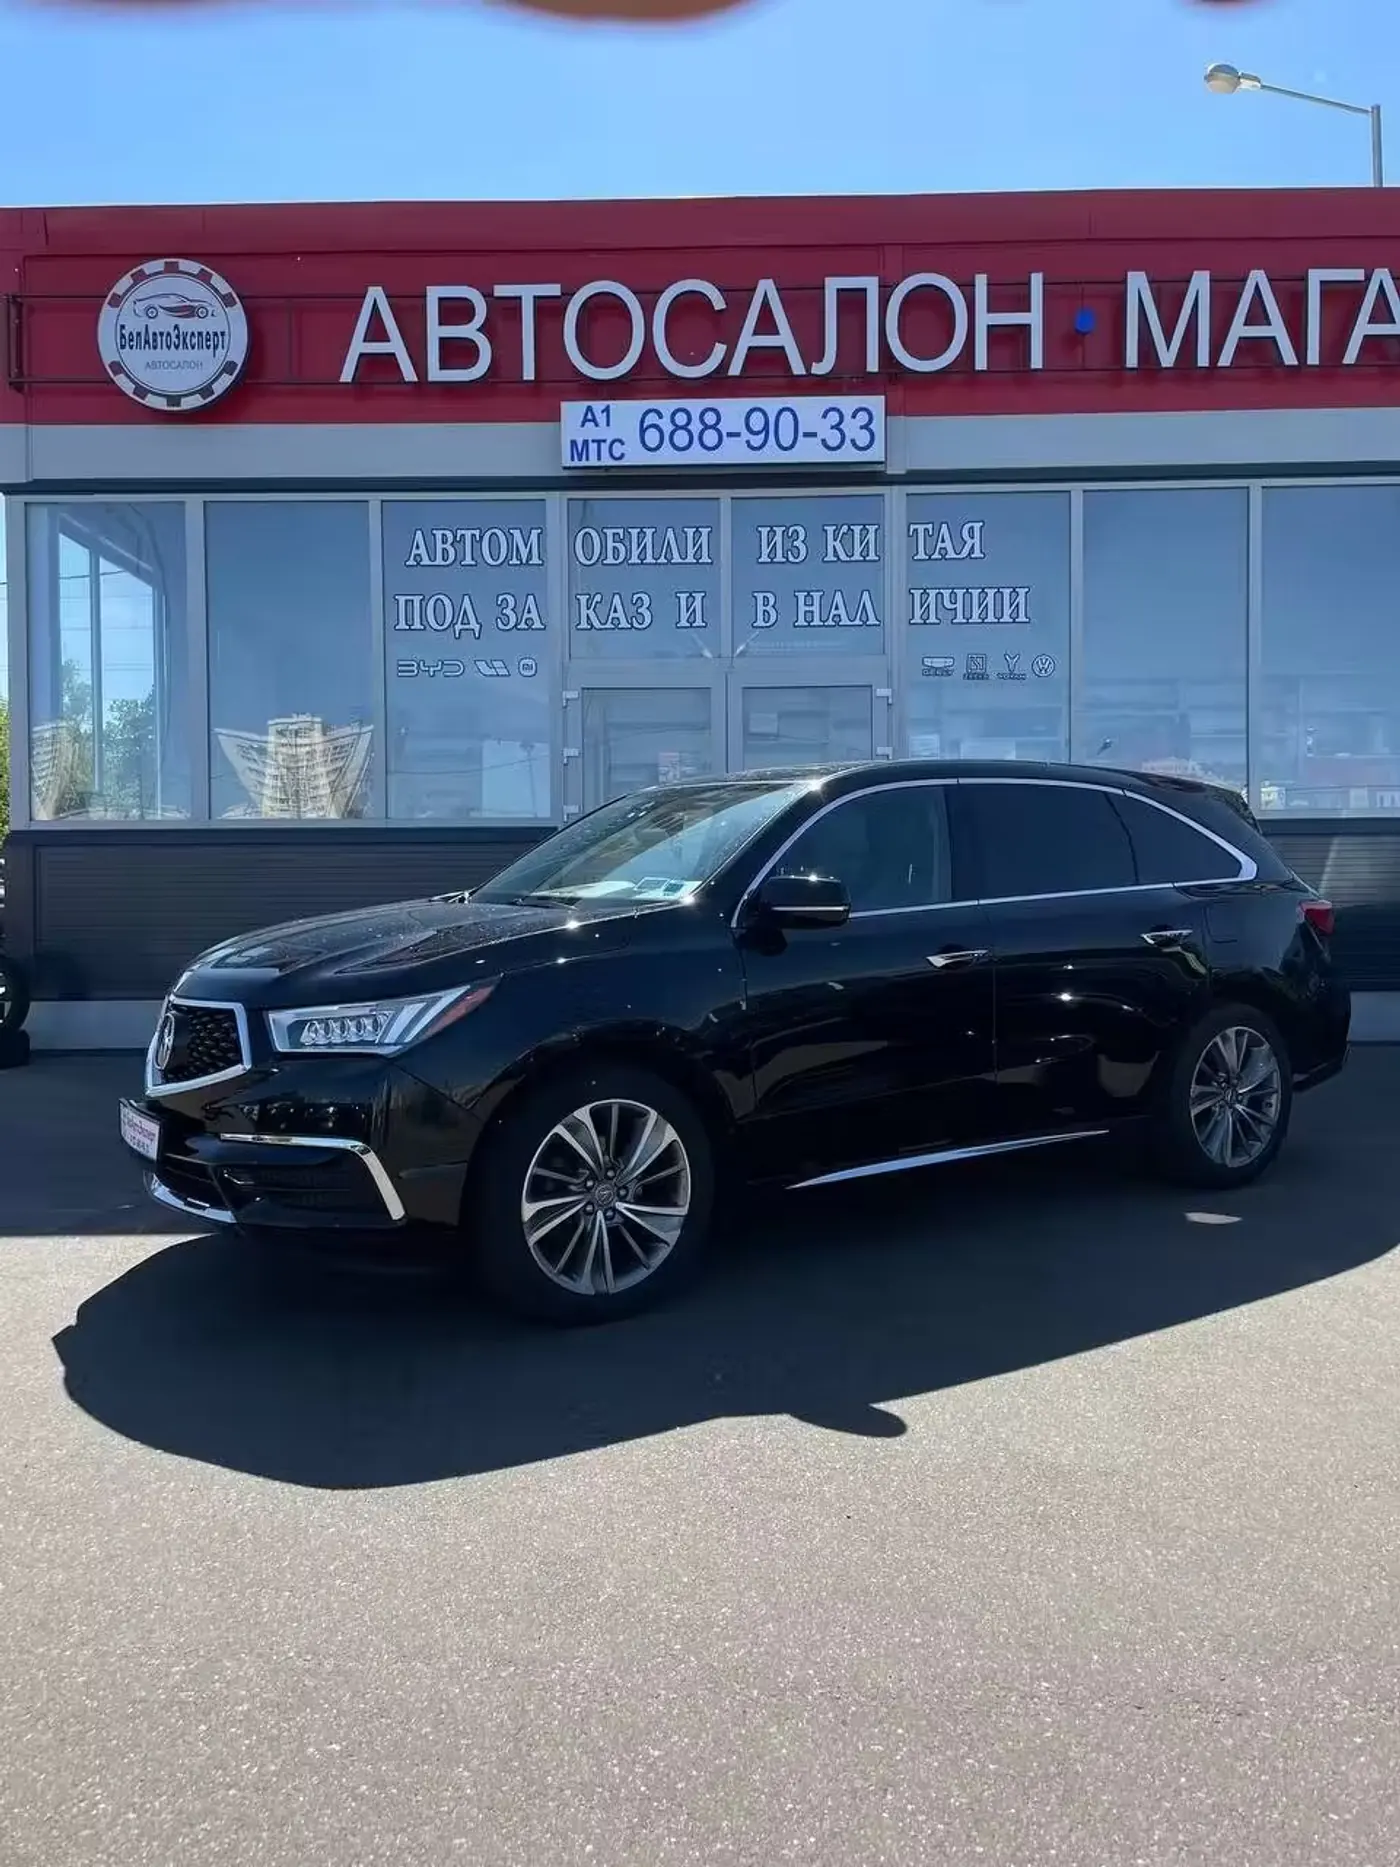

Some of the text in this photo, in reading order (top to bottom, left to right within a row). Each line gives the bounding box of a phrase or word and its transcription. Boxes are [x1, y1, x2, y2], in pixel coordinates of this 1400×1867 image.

[119, 323, 226, 358] БелАвтоЭксперт
[339, 267, 1400, 383] АВТОСАЛОН МАГА
[145, 360, 203, 371] АВТОСАЛОН
[580, 404, 612, 429] A1
[638, 406, 875, 452] 688-90-33
[570, 438, 626, 463] МТС
[757, 524, 808, 564] ИЗ
[394, 593, 482, 639] ПОД
[675, 591, 707, 629] И
[752, 590, 779, 628] В
[397, 659, 465, 678] BYD
